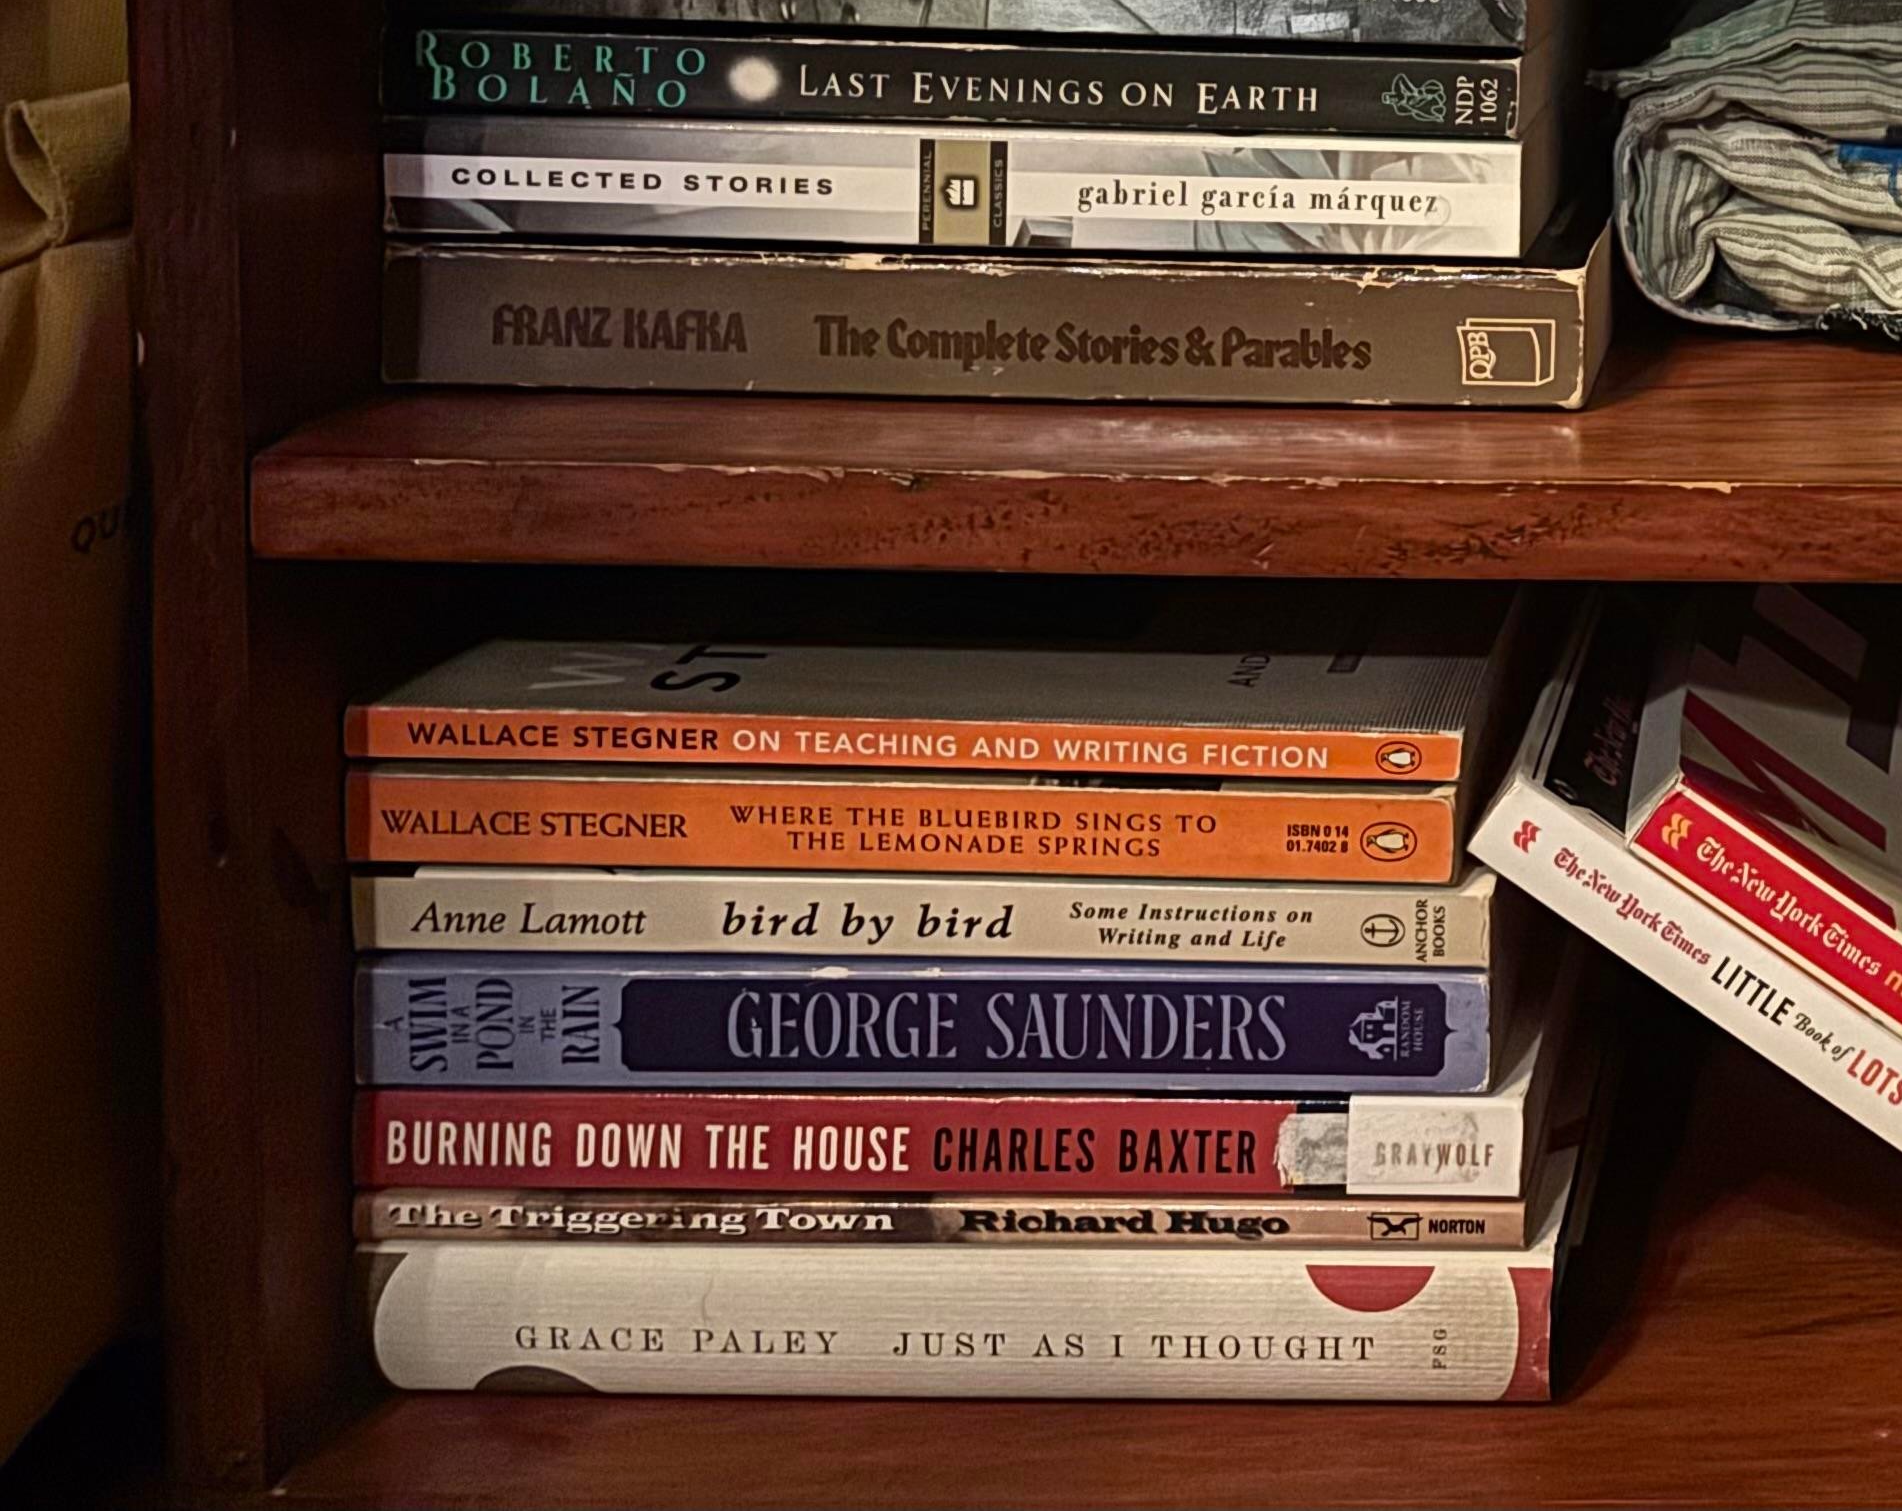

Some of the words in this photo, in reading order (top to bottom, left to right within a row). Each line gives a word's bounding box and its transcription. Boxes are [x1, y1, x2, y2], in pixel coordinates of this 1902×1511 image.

[1454, 75, 1474, 126] NDP
[1479, 77, 1499, 124] 1062
[451, 167, 664, 191] COLLECTED
[683, 173, 836, 197] STORIES
[1077, 179, 1189, 216] gabriel
[1200, 185, 1297, 216] garcía
[1309, 187, 1440, 220] márquez
[407, 721, 559, 749] WALLACE
[573, 724, 719, 751] STEGNER
[732, 729, 781, 751] ON
[794, 731, 957, 757] TEACHING
[971, 737, 1040, 759] AND
[1053, 739, 1189, 765] WRITING
[1202, 743, 1328, 770] FICTION
[1287, 825, 1320, 838] ISBN
[1323, 825, 1331, 838] 0
[1334, 825, 1349, 838] 14
[411, 901, 506, 935] Anne
[520, 903, 647, 935] Lamott
[722, 901, 820, 936] bird
[841, 903, 894, 944] by
[917, 904, 1013, 939] bird
[1710, 956, 1795, 1026] LITTLE
[727, 991, 958, 1059] GEORGE
[984, 992, 1286, 1061] SAUNDERS
[387, 1120, 553, 1167] BURNING
[576, 1123, 682, 1168] DOWN
[705, 1124, 770, 1170] THE
[793, 1127, 910, 1172] HOUSE
[933, 1128, 1095, 1173] CHARLES
[1118, 1129, 1256, 1174] BAXTER
[1429, 1218, 1485, 1235] NORTON
